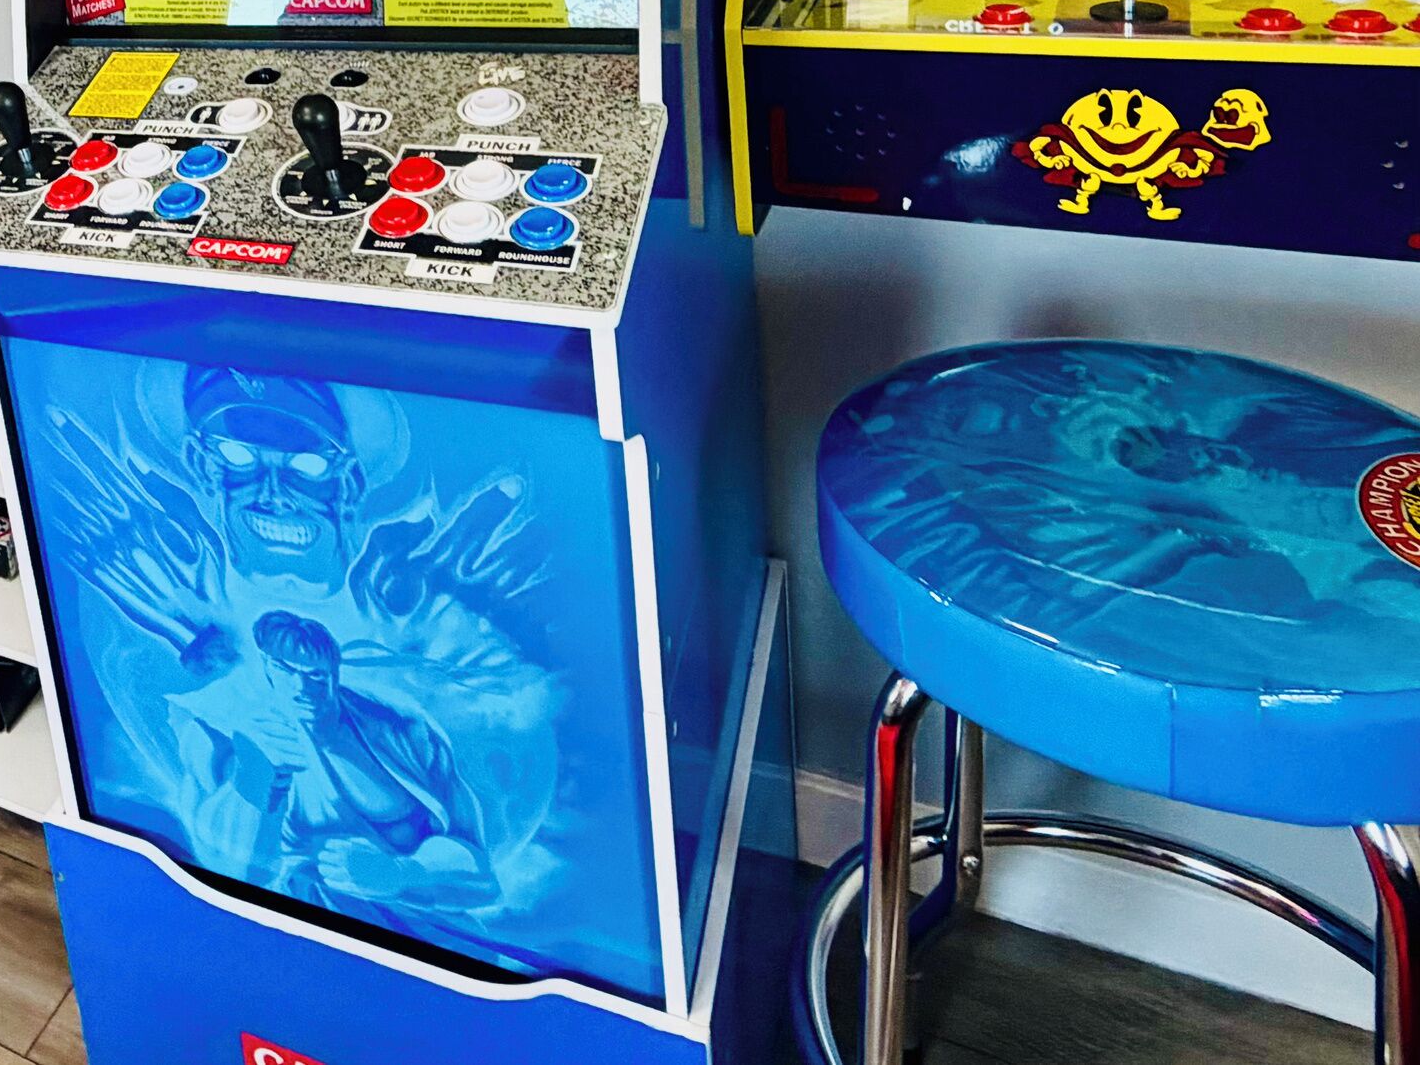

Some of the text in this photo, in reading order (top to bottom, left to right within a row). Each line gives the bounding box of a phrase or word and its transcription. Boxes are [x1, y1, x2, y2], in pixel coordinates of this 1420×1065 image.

[142, 124, 195, 136] PUNCH
[466, 138, 532, 153] PUNCH
[79, 231, 118, 244] KICK
[373, 239, 406, 250] SHORT
[433, 244, 482, 257] FORWARD
[497, 250, 571, 265] ROUNDHOUSE
[426, 262, 475, 278] KICK
